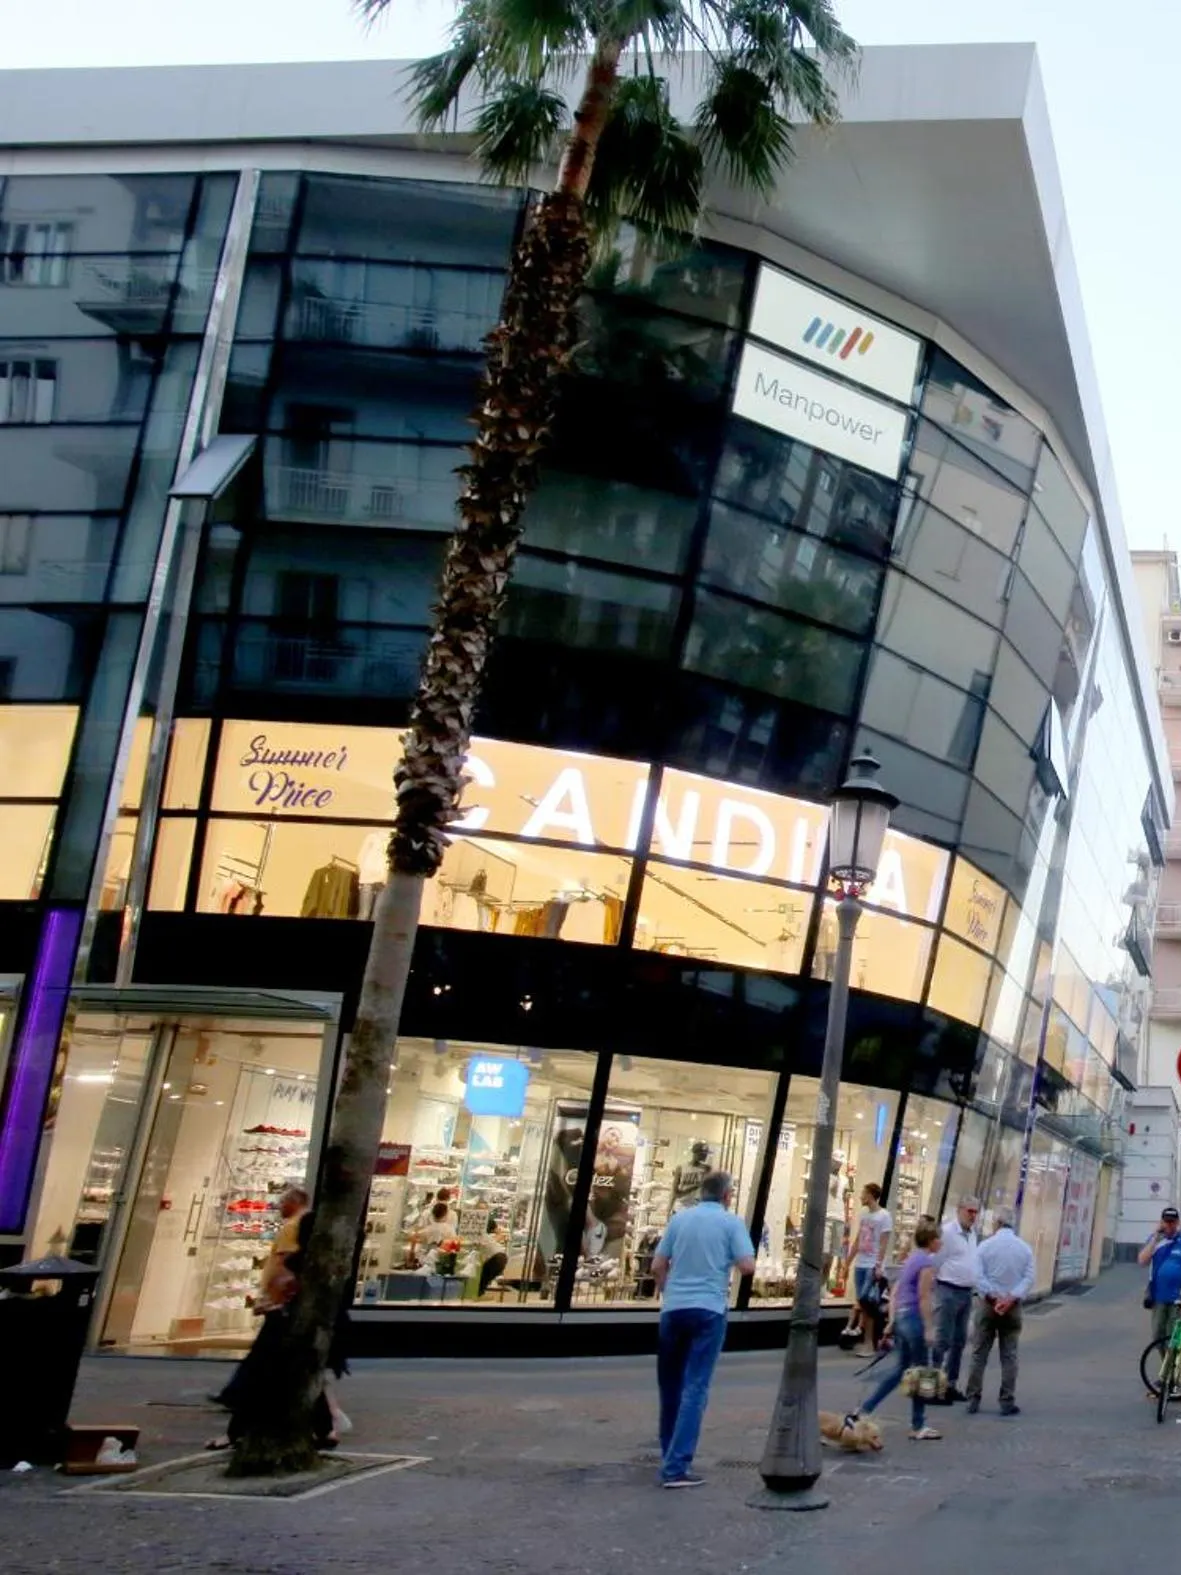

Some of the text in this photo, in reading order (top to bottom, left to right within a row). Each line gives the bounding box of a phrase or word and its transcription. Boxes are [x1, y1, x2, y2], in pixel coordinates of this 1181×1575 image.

[754, 372, 883, 445] Manpower
[240, 734, 347, 771] Summer
[248, 769, 332, 808] Price
[443, 754, 908, 926] CANDIA
[472, 1075, 504, 1088] LAB
[474, 1061, 504, 1074] AW
